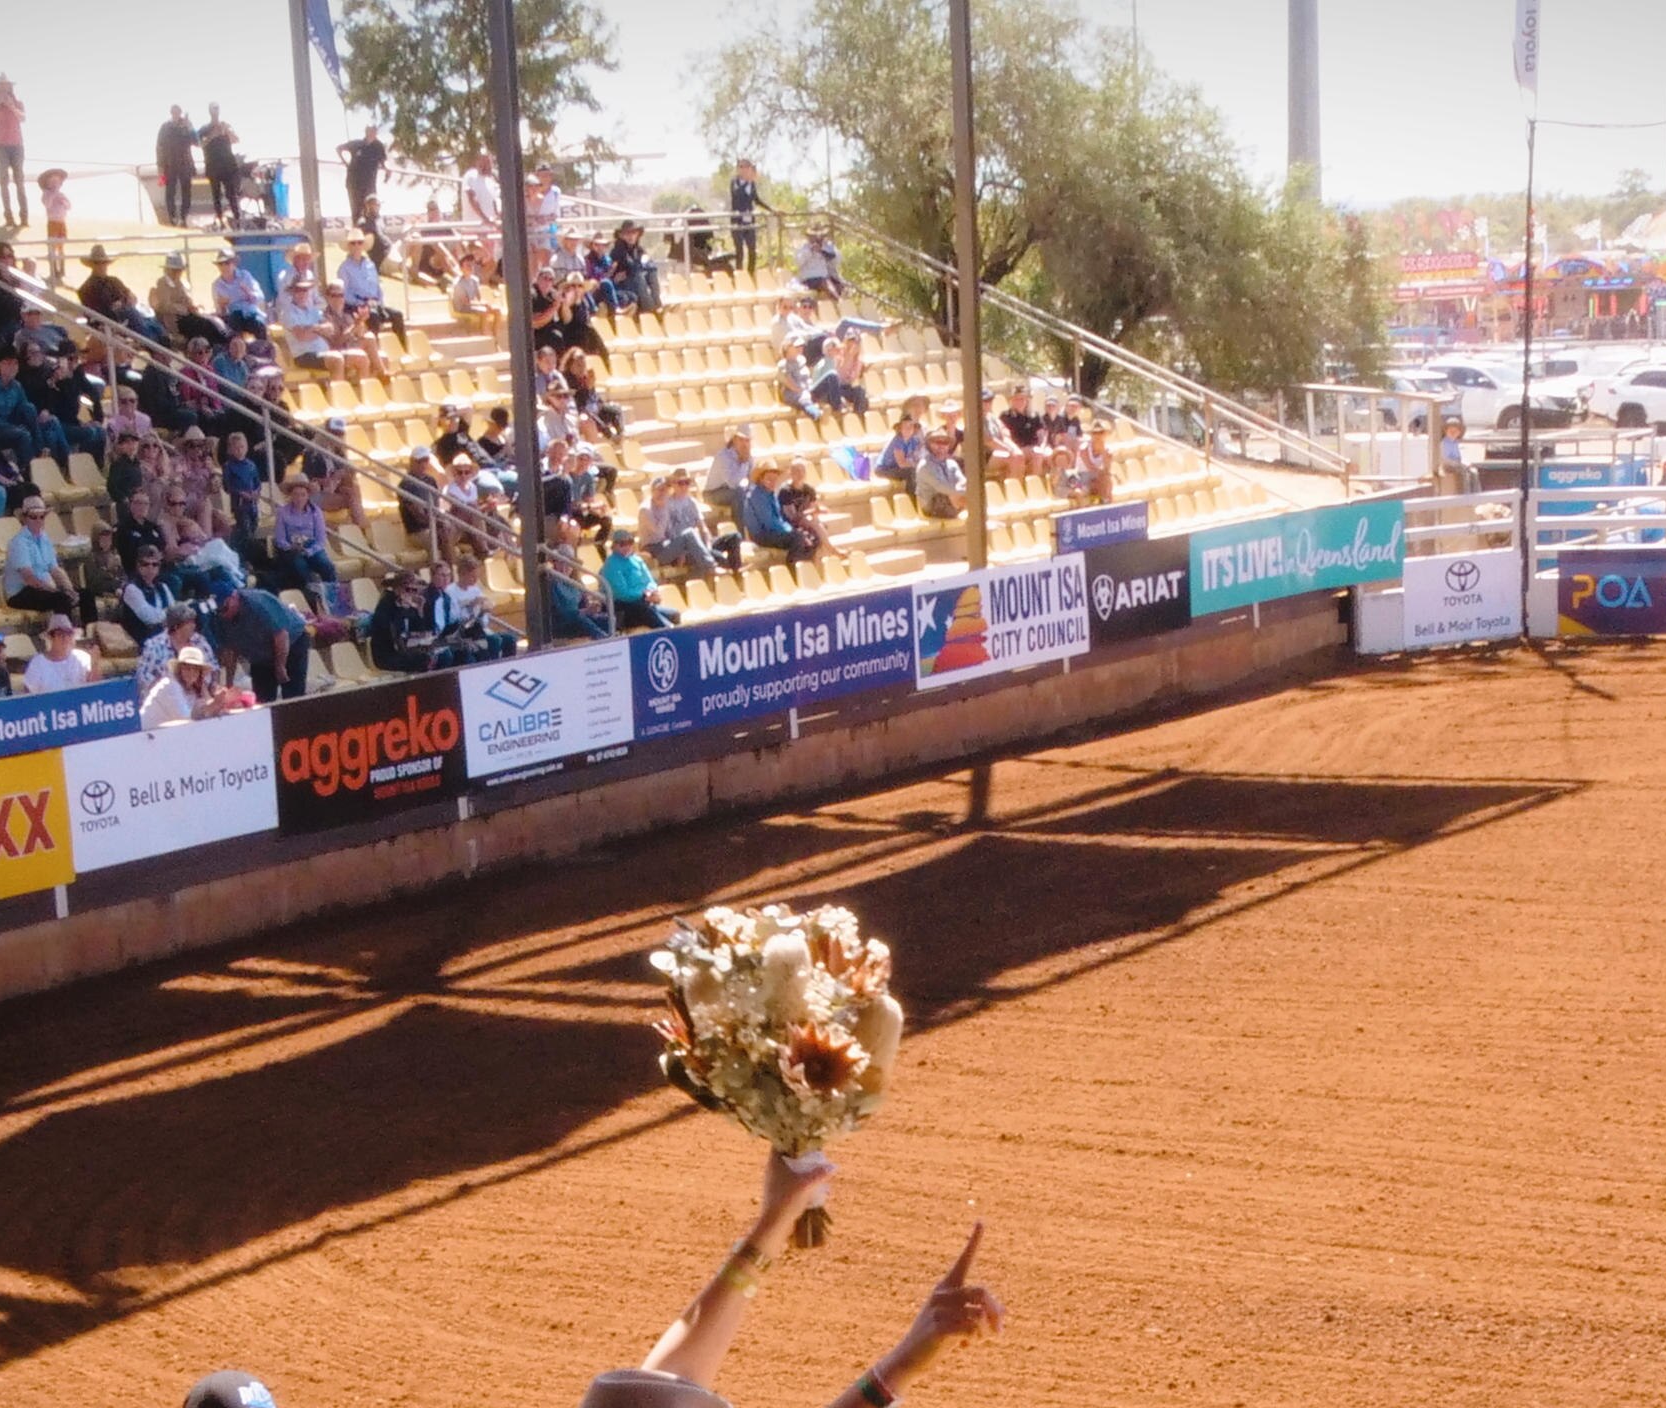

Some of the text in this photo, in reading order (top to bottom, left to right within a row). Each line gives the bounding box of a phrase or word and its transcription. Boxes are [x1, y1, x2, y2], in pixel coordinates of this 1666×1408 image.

[1077, 522, 1106, 540] Mount
[1237, 536, 1282, 584] LIVE!
[1296, 516, 1402, 577] Queensland
[989, 565, 1085, 625] MOUNT ISA
[1115, 571, 1183, 611] ARIAT
[1443, 594, 1483, 607] TOYOTA
[1572, 573, 1653, 609] POA
[698, 606, 909, 681] Mount Isa Mines
[991, 615, 1086, 660] CITY COUNCIL
[1414, 615, 1511, 638] Bell & Moir Toyota
[701, 648, 910, 716] proudly supporting our community
[51, 708, 79, 731] Isa
[81, 698, 135, 726] Mines
[478, 707, 563, 742] CALIBRE
[280, 694, 461, 797] aggreko
[487, 729, 561, 756] ENGINEERING
[129, 763, 269, 808] Bell & Moir Toyota
[79, 815, 121, 834] TOYOTA
